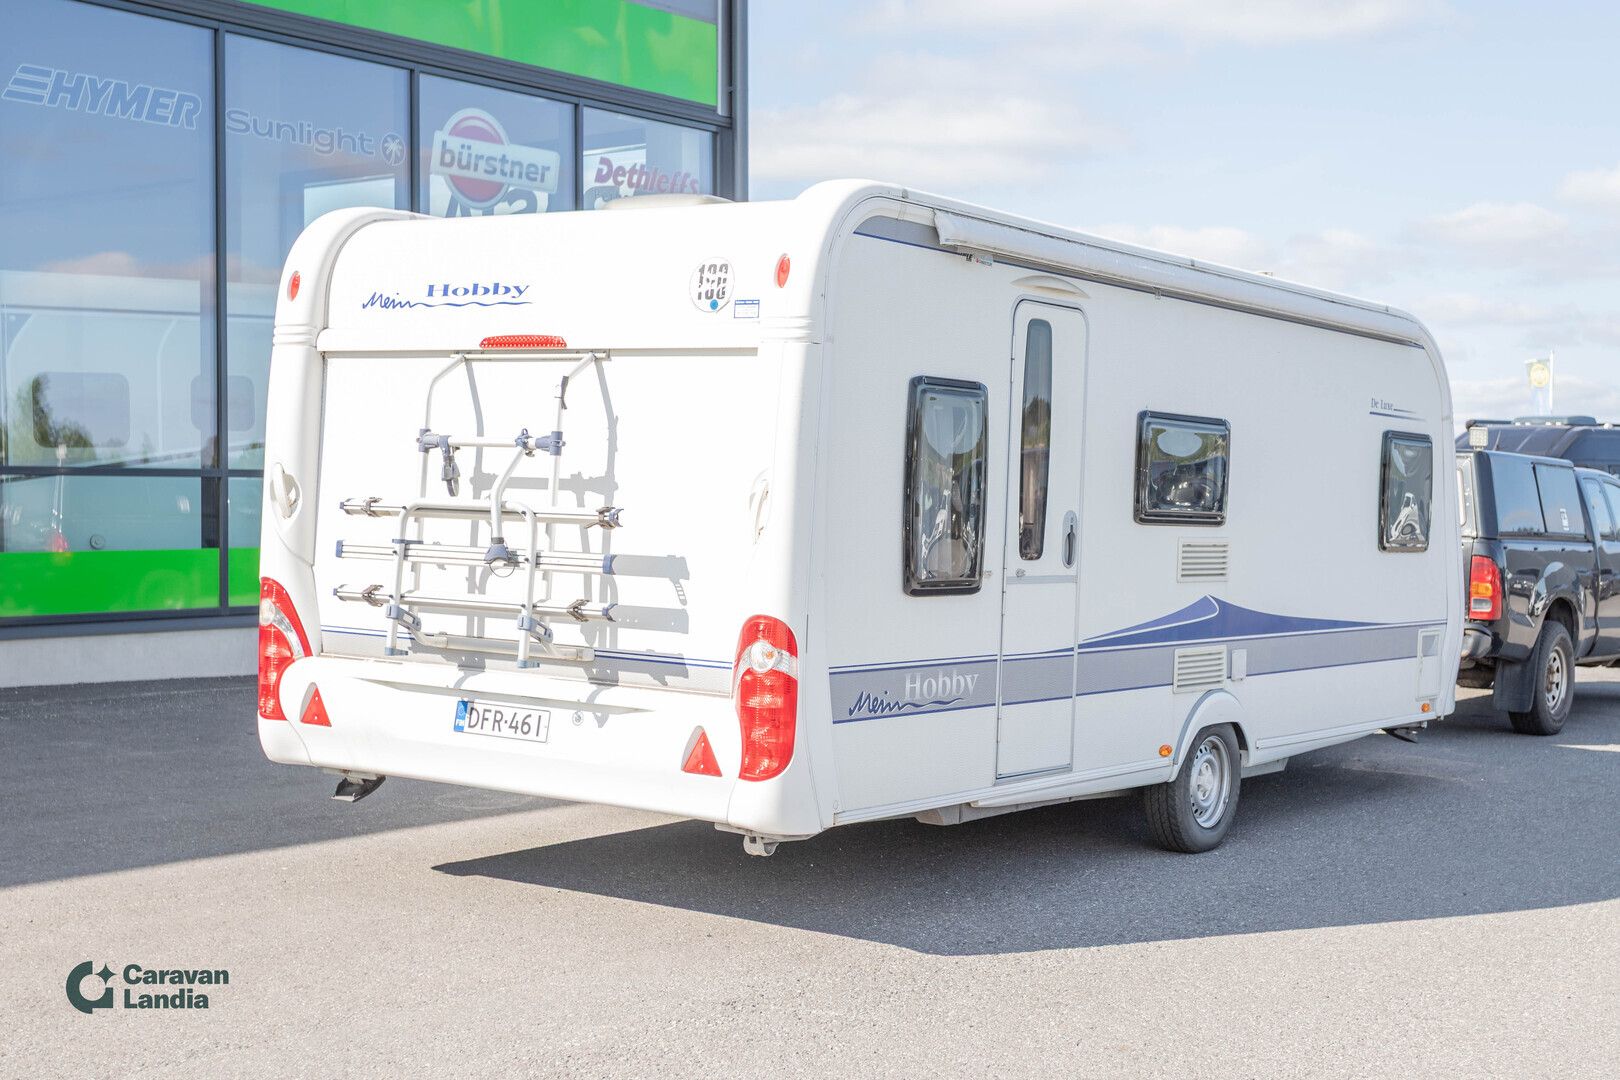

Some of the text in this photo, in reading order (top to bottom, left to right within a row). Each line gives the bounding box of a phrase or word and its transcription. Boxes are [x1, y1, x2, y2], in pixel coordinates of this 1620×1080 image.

[47, 69, 202, 130] HYMER
[226, 108, 376, 156] Sunlight
[439, 140, 551, 184] bürstner
[594, 156, 699, 194] Dethleffs
[362, 282, 531, 310] Mein Hobby
[848, 669, 980, 717] Mein Hobby
